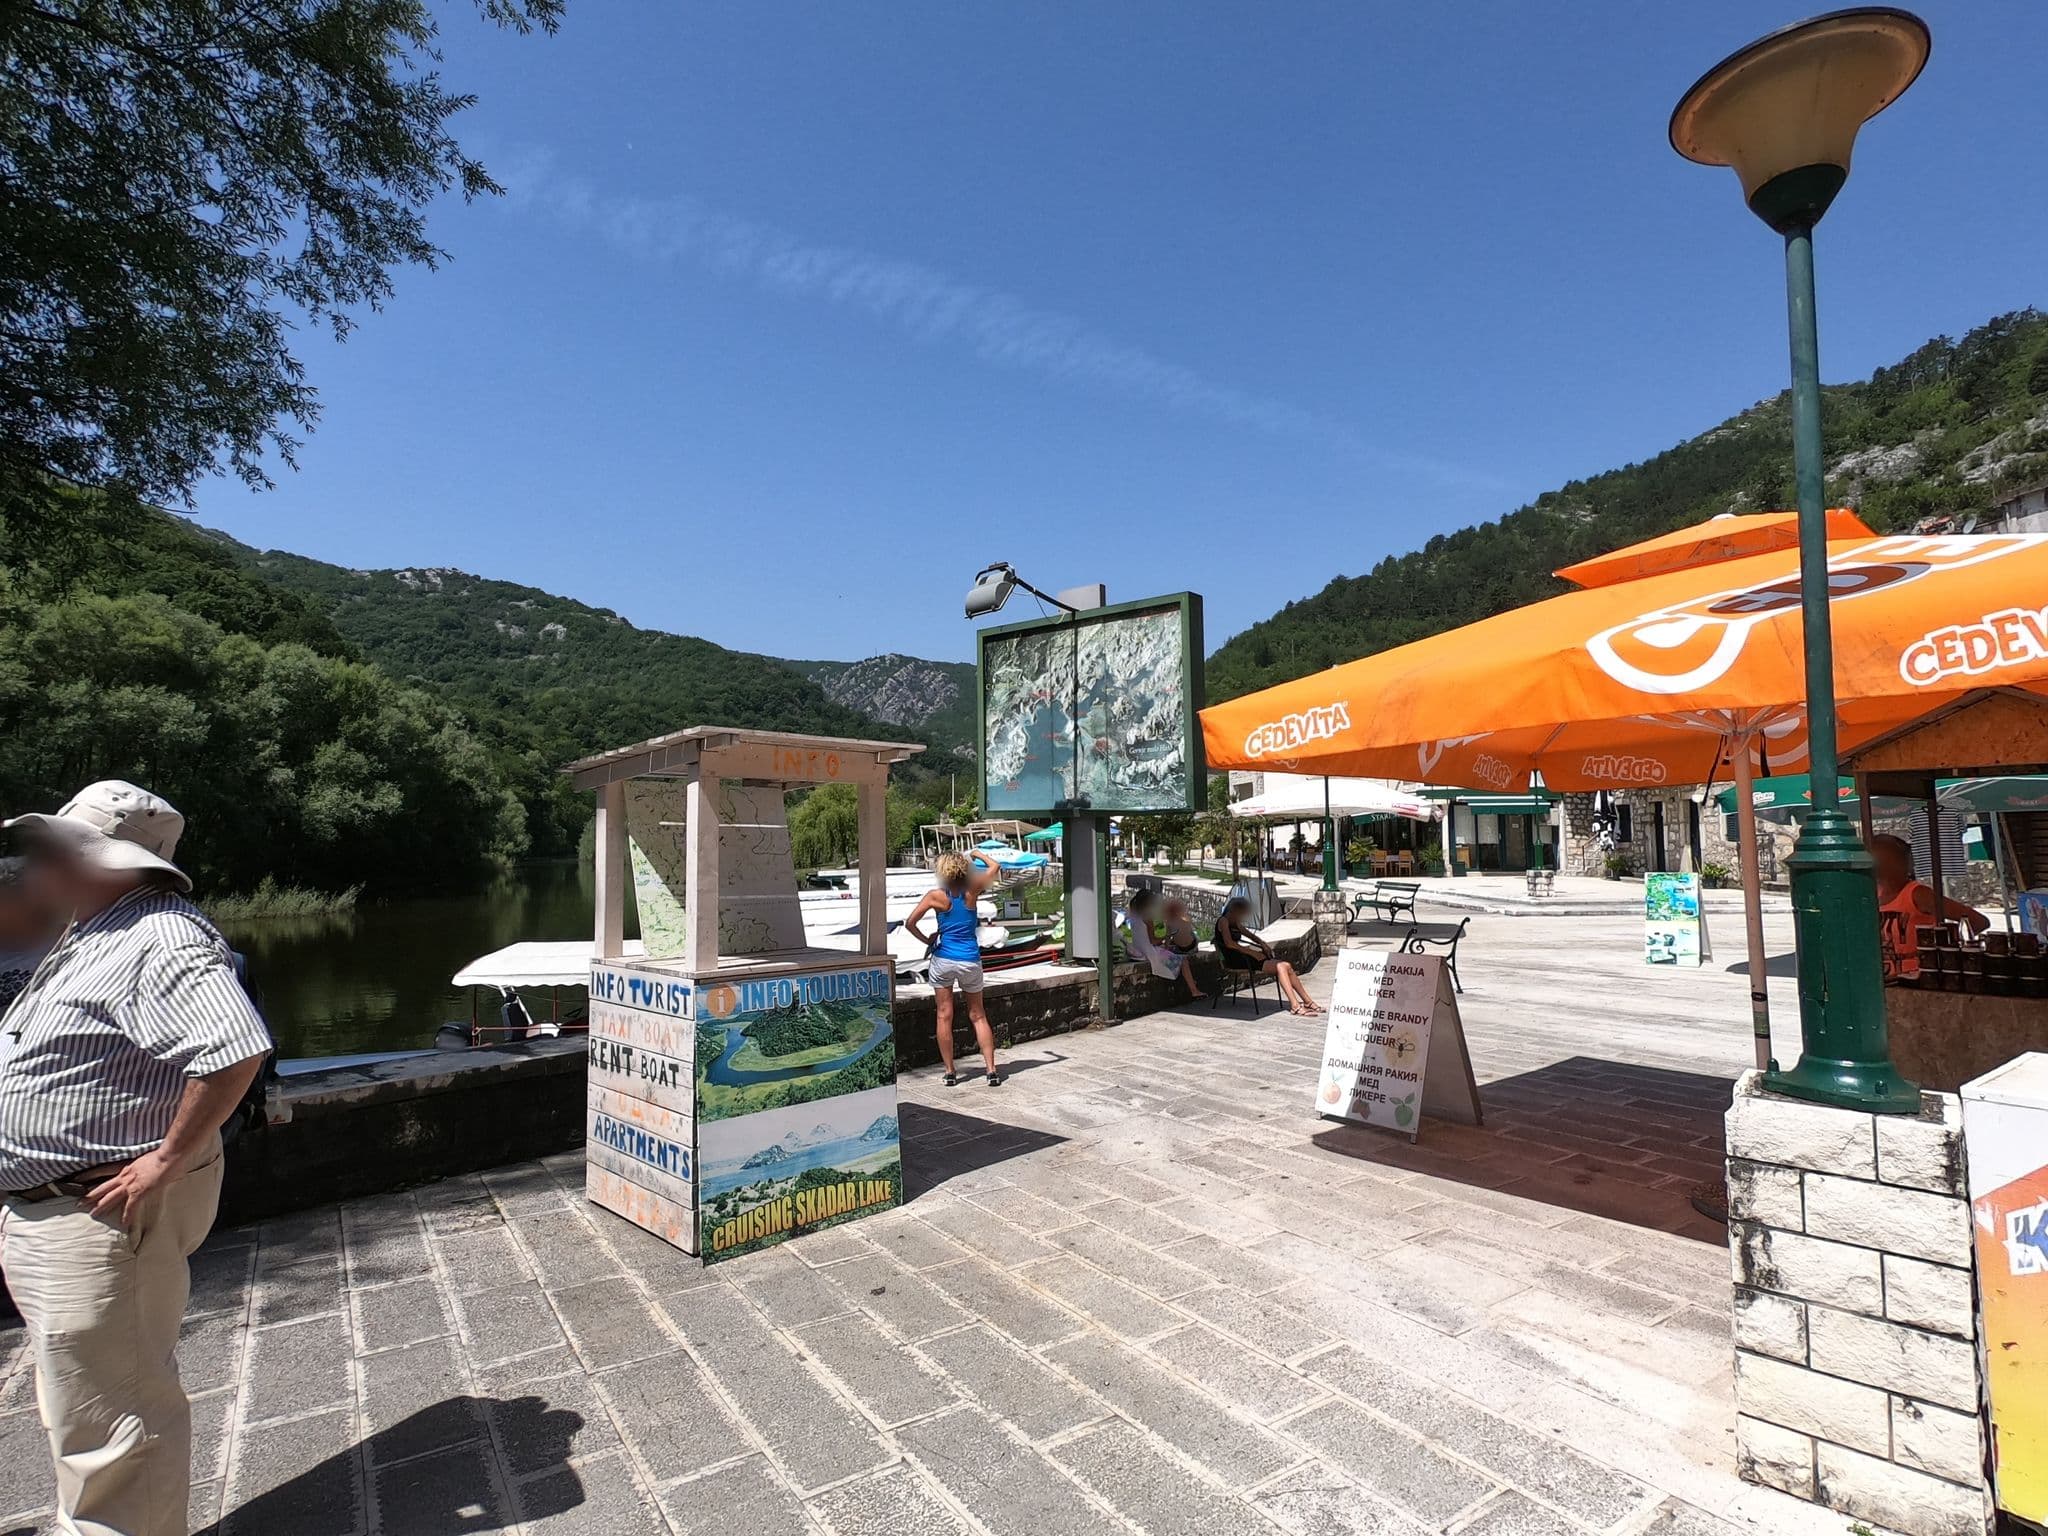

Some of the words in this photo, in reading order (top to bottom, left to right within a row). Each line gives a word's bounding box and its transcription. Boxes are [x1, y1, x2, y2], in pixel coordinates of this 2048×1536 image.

[1245, 703, 1350, 757] CEDEVITA
[773, 750, 840, 778] INFO
[1373, 976, 1393, 986] MED
[1390, 965, 1424, 977] RAKIJA
[591, 971, 625, 1001] INFO
[629, 978, 690, 1015] TURIST
[740, 979, 793, 1013] INFO
[798, 968, 881, 1006] TOURIST
[1368, 988, 1395, 999] LIKER
[1333, 1004, 1385, 1020] HOMEMADE
[1387, 1011, 1429, 1026] BRANDY
[1361, 1021, 1394, 1033] HONEY
[1355, 1033, 1396, 1048] LIQUEUR
[590, 1038, 633, 1077] RENT
[641, 1055, 679, 1089] BOAT
[1328, 1058, 1383, 1076] ДОМАШНЯЯ
[1385, 1068, 1418, 1083] РАКИЯ
[1359, 1076, 1380, 1090] МЕД
[1349, 1088, 1387, 1103] ЛИКЕРЕ
[594, 1114, 690, 1179] APARTMENTS
[713, 1195, 793, 1252] CRUISING
[795, 1182, 856, 1226] SKADAR
[859, 1180, 892, 1207] LAKE
